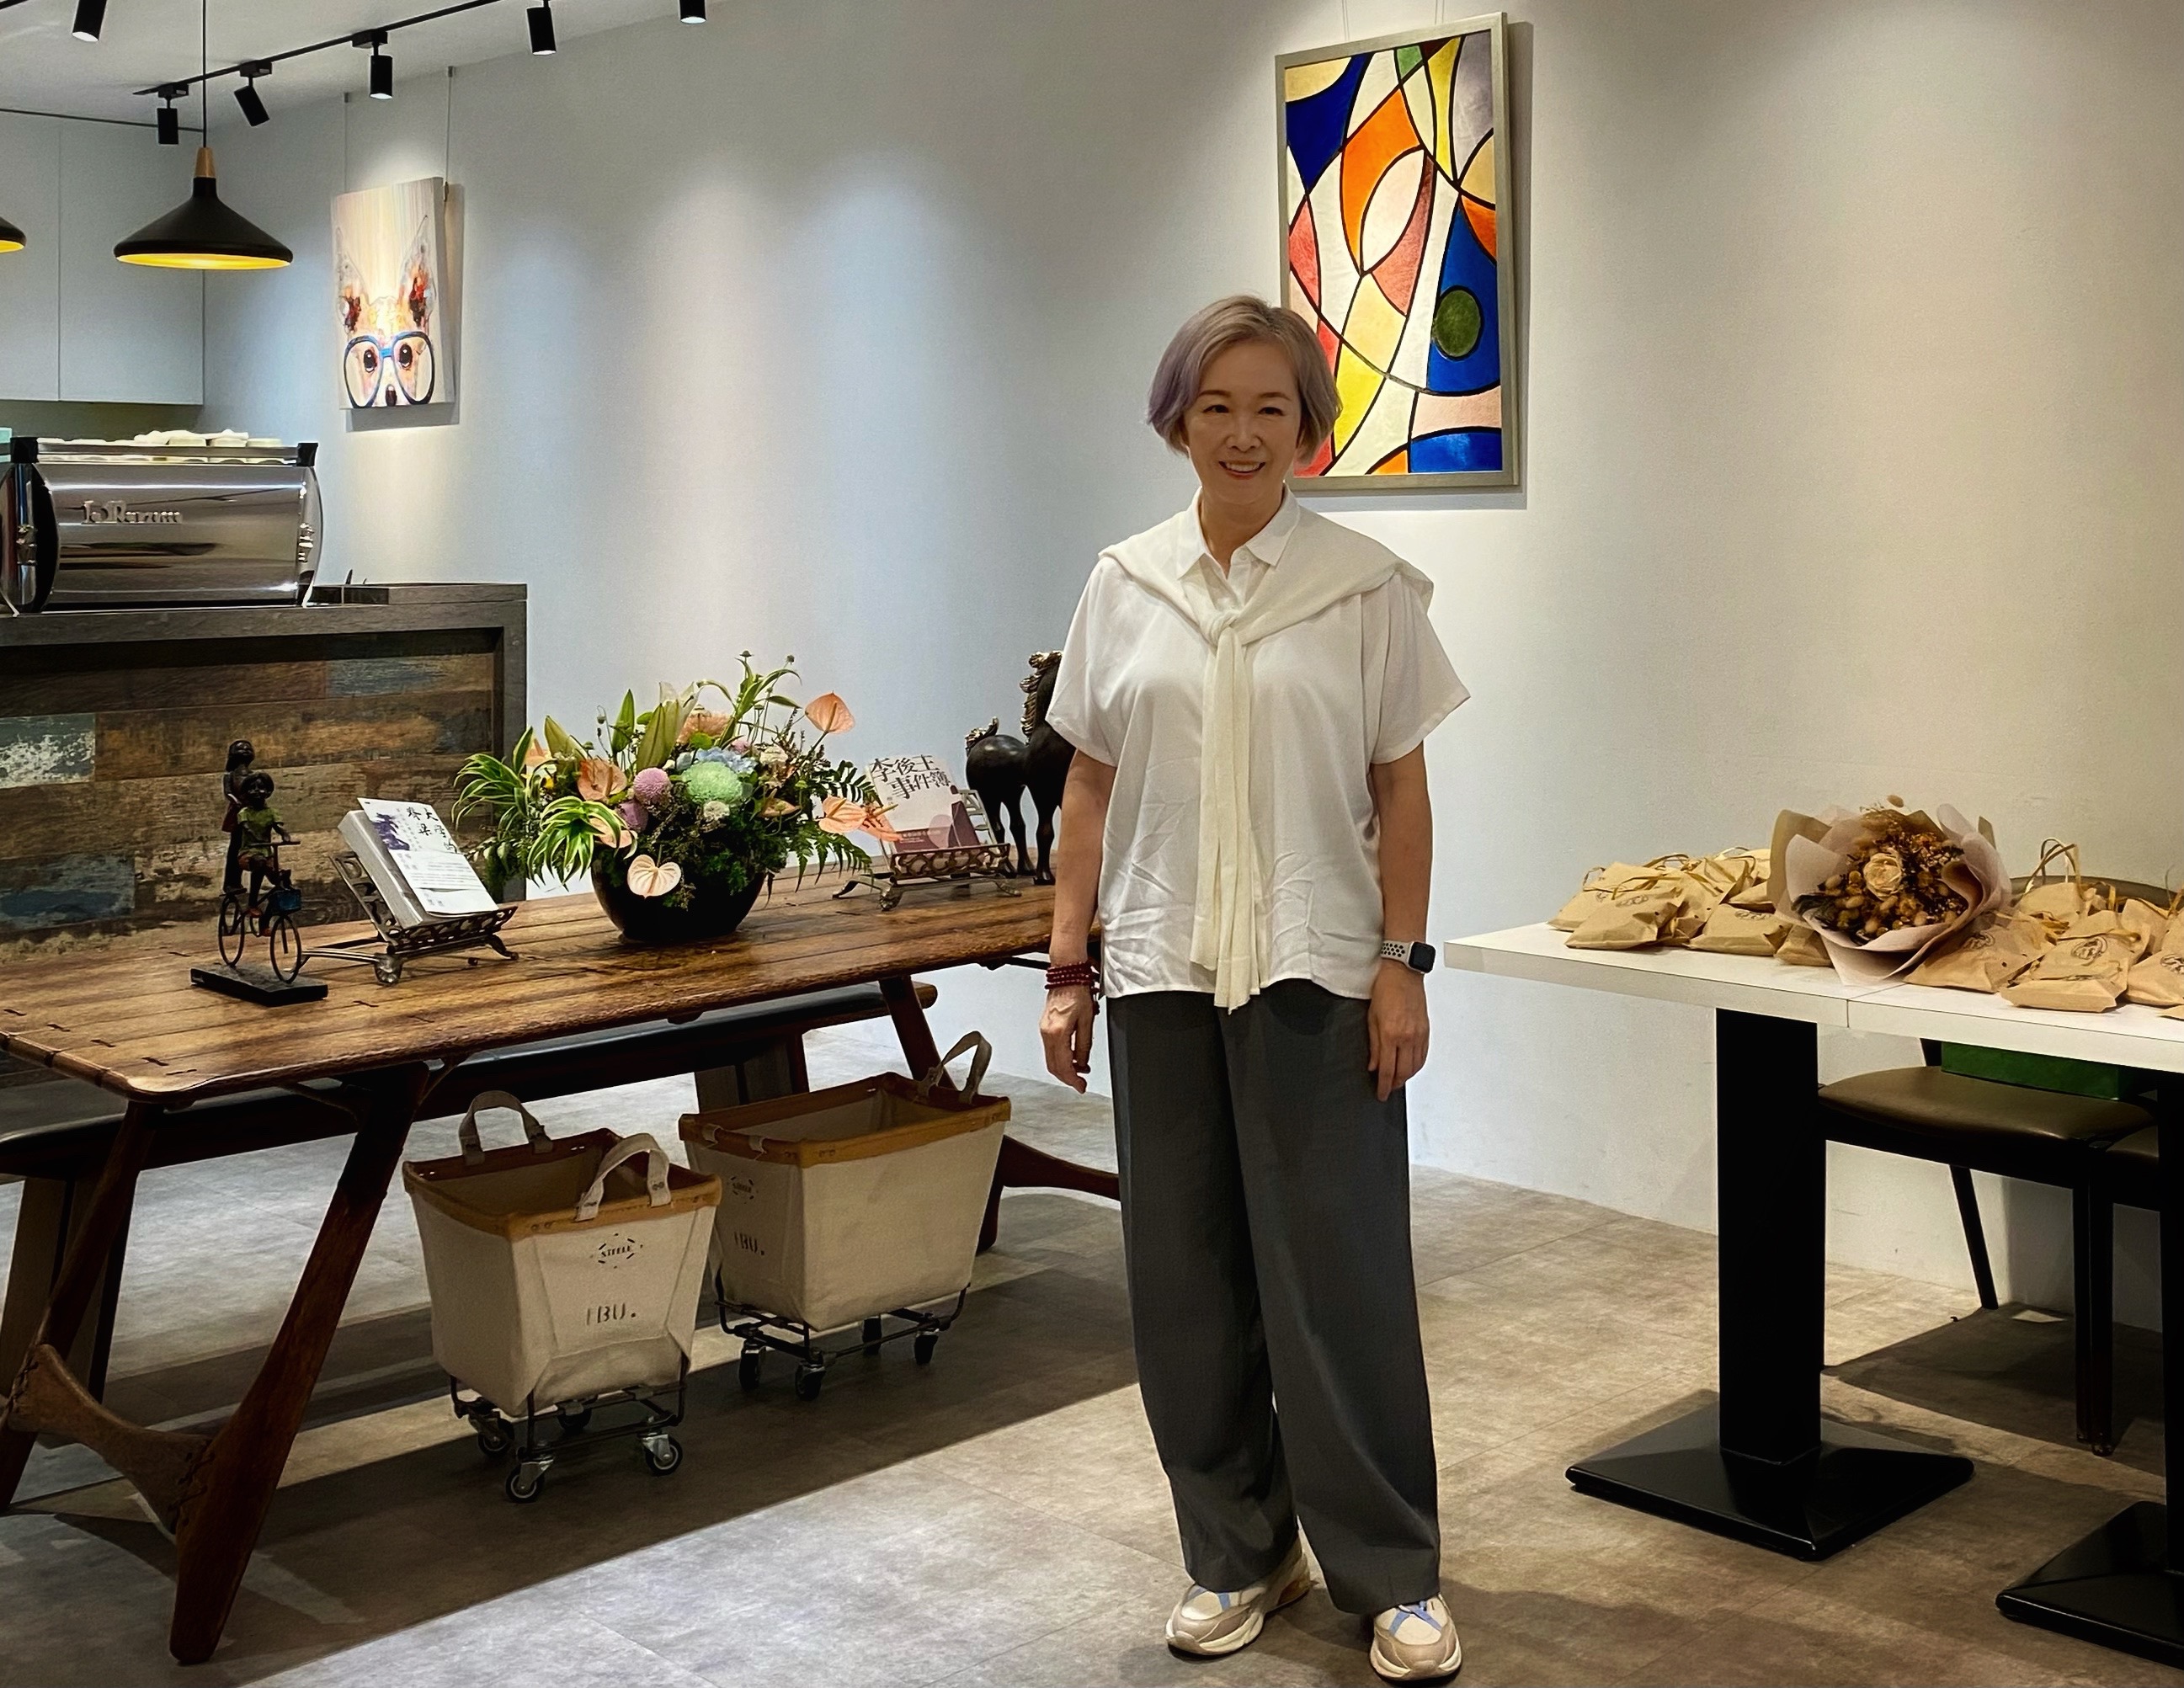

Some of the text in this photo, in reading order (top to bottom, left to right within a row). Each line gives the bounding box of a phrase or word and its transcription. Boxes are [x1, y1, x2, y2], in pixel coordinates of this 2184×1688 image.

[870, 754, 940, 782] 李後主
[887, 770, 951, 799] 事件簿
